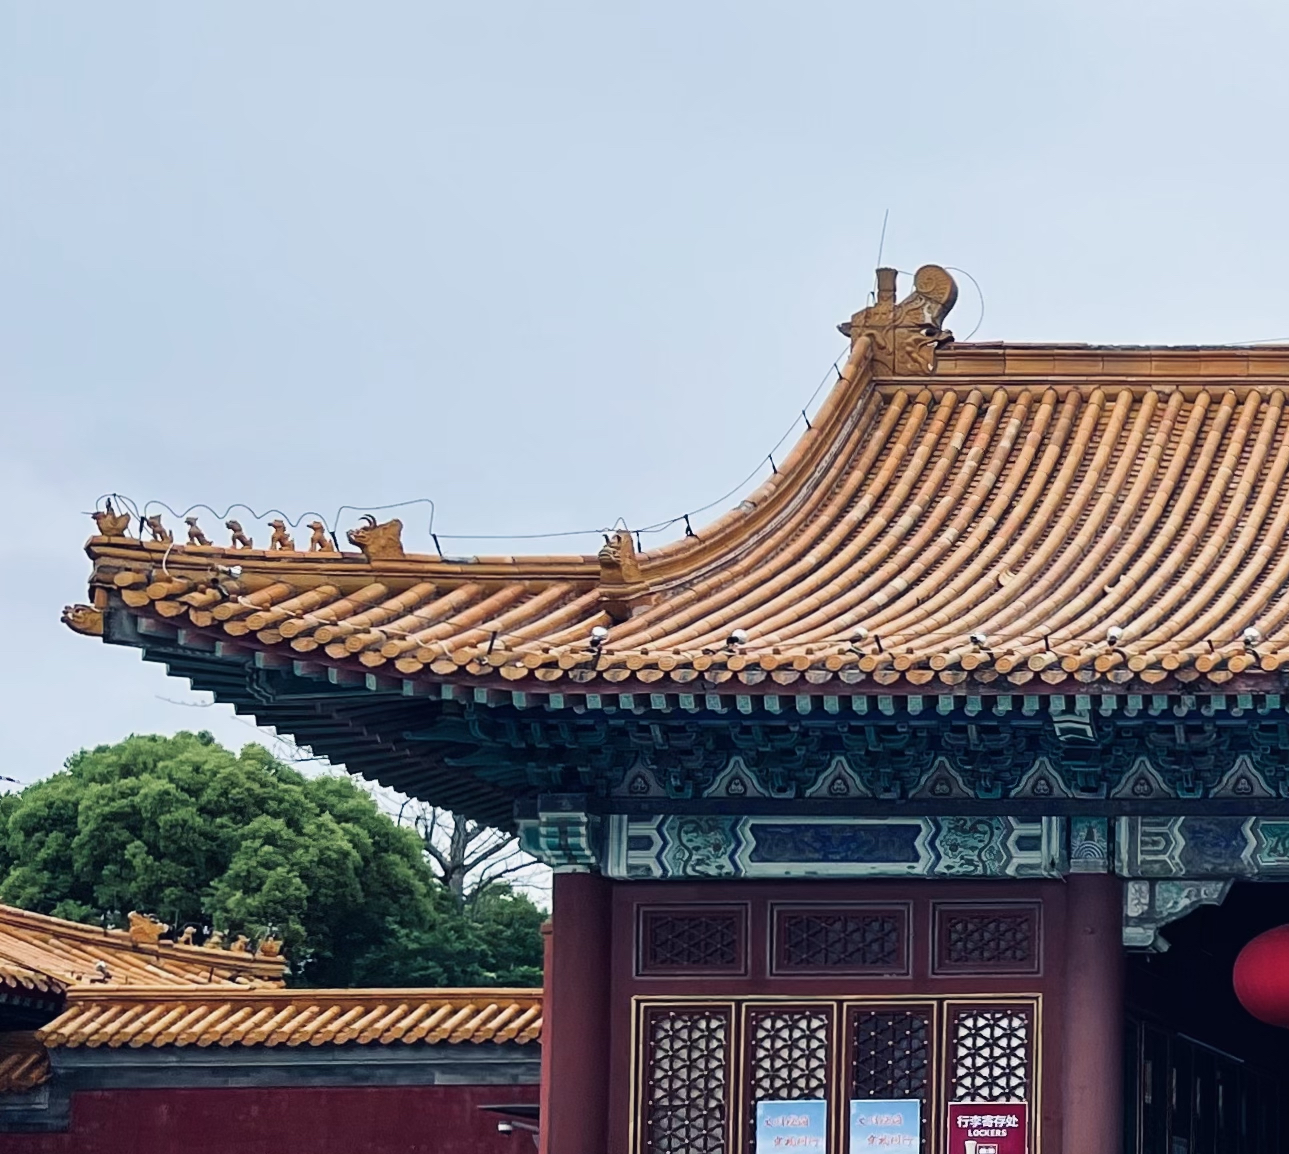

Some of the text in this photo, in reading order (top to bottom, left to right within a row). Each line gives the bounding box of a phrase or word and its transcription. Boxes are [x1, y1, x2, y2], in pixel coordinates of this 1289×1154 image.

[957, 1115, 1019, 1128] 行李寄存处
[968, 1129, 1007, 1137] LOCKERS
